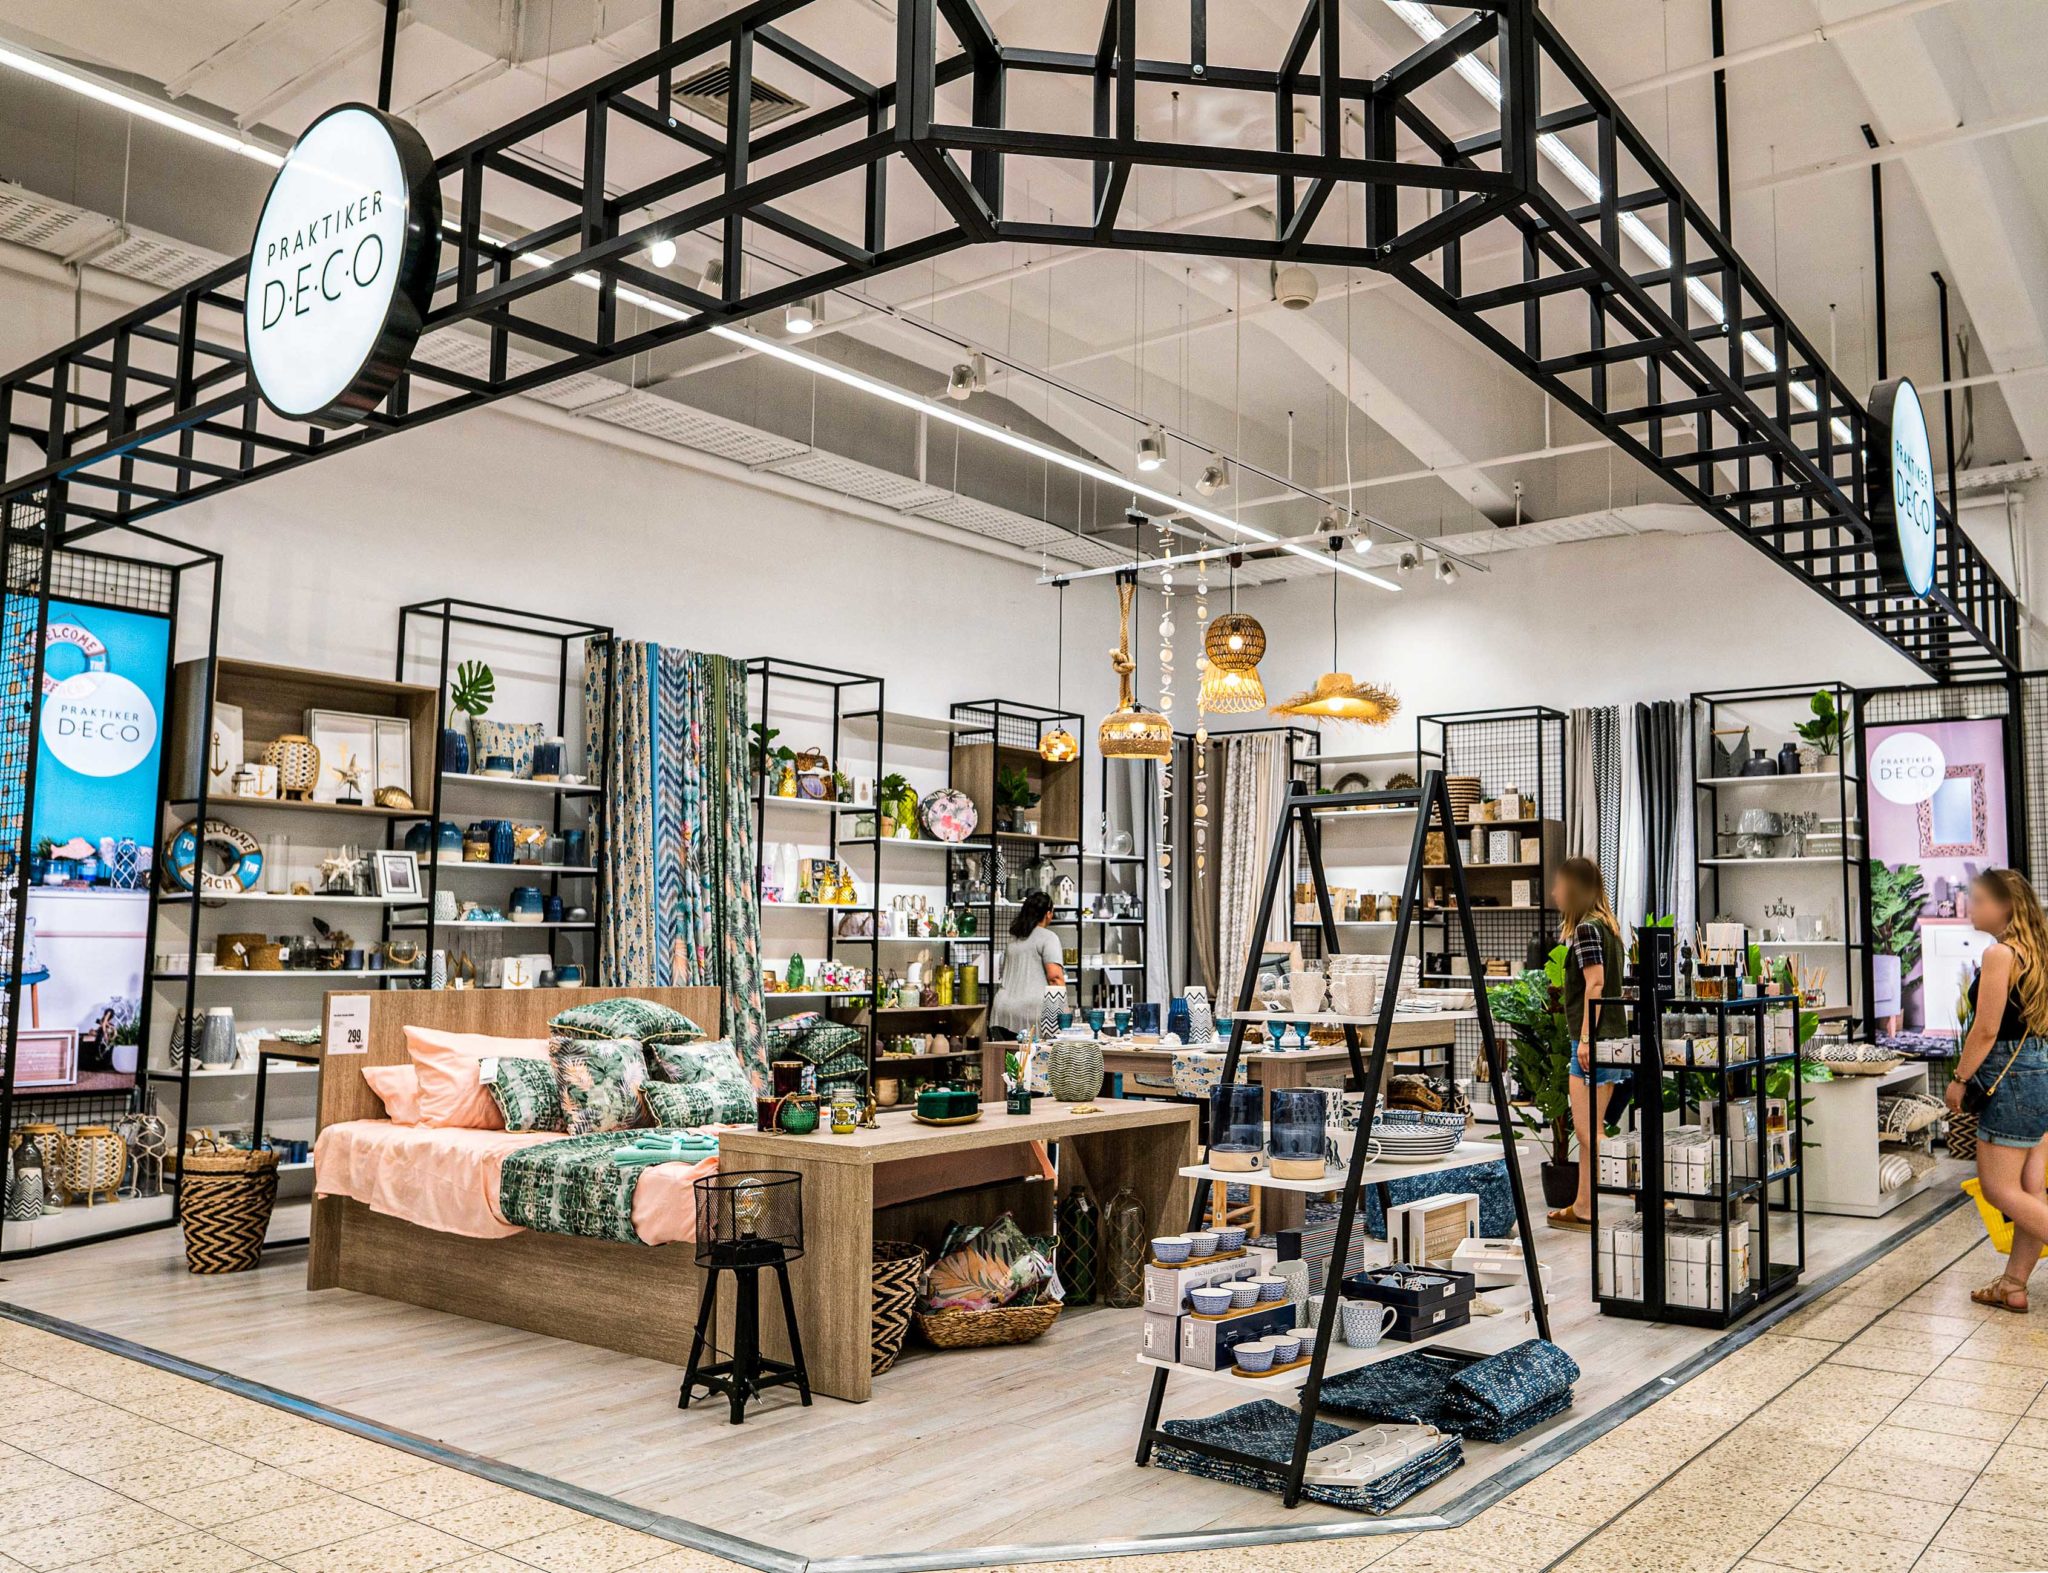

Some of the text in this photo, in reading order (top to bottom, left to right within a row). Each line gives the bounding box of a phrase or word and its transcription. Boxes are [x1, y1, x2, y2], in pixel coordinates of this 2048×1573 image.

[267, 190, 383, 267] PRAKTIKER
[1896, 439, 1928, 489] PRAKTIKER
[47, 627, 97, 651] ELCOME
[61, 704, 139, 721] PRAKTIKER
[1880, 756, 1932, 766] PRAKTIKER
[183, 839, 195, 851] TO
[204, 822, 255, 852] ELCOME
[245, 860, 260, 874] THE
[347, 1029, 362, 1043] 299
